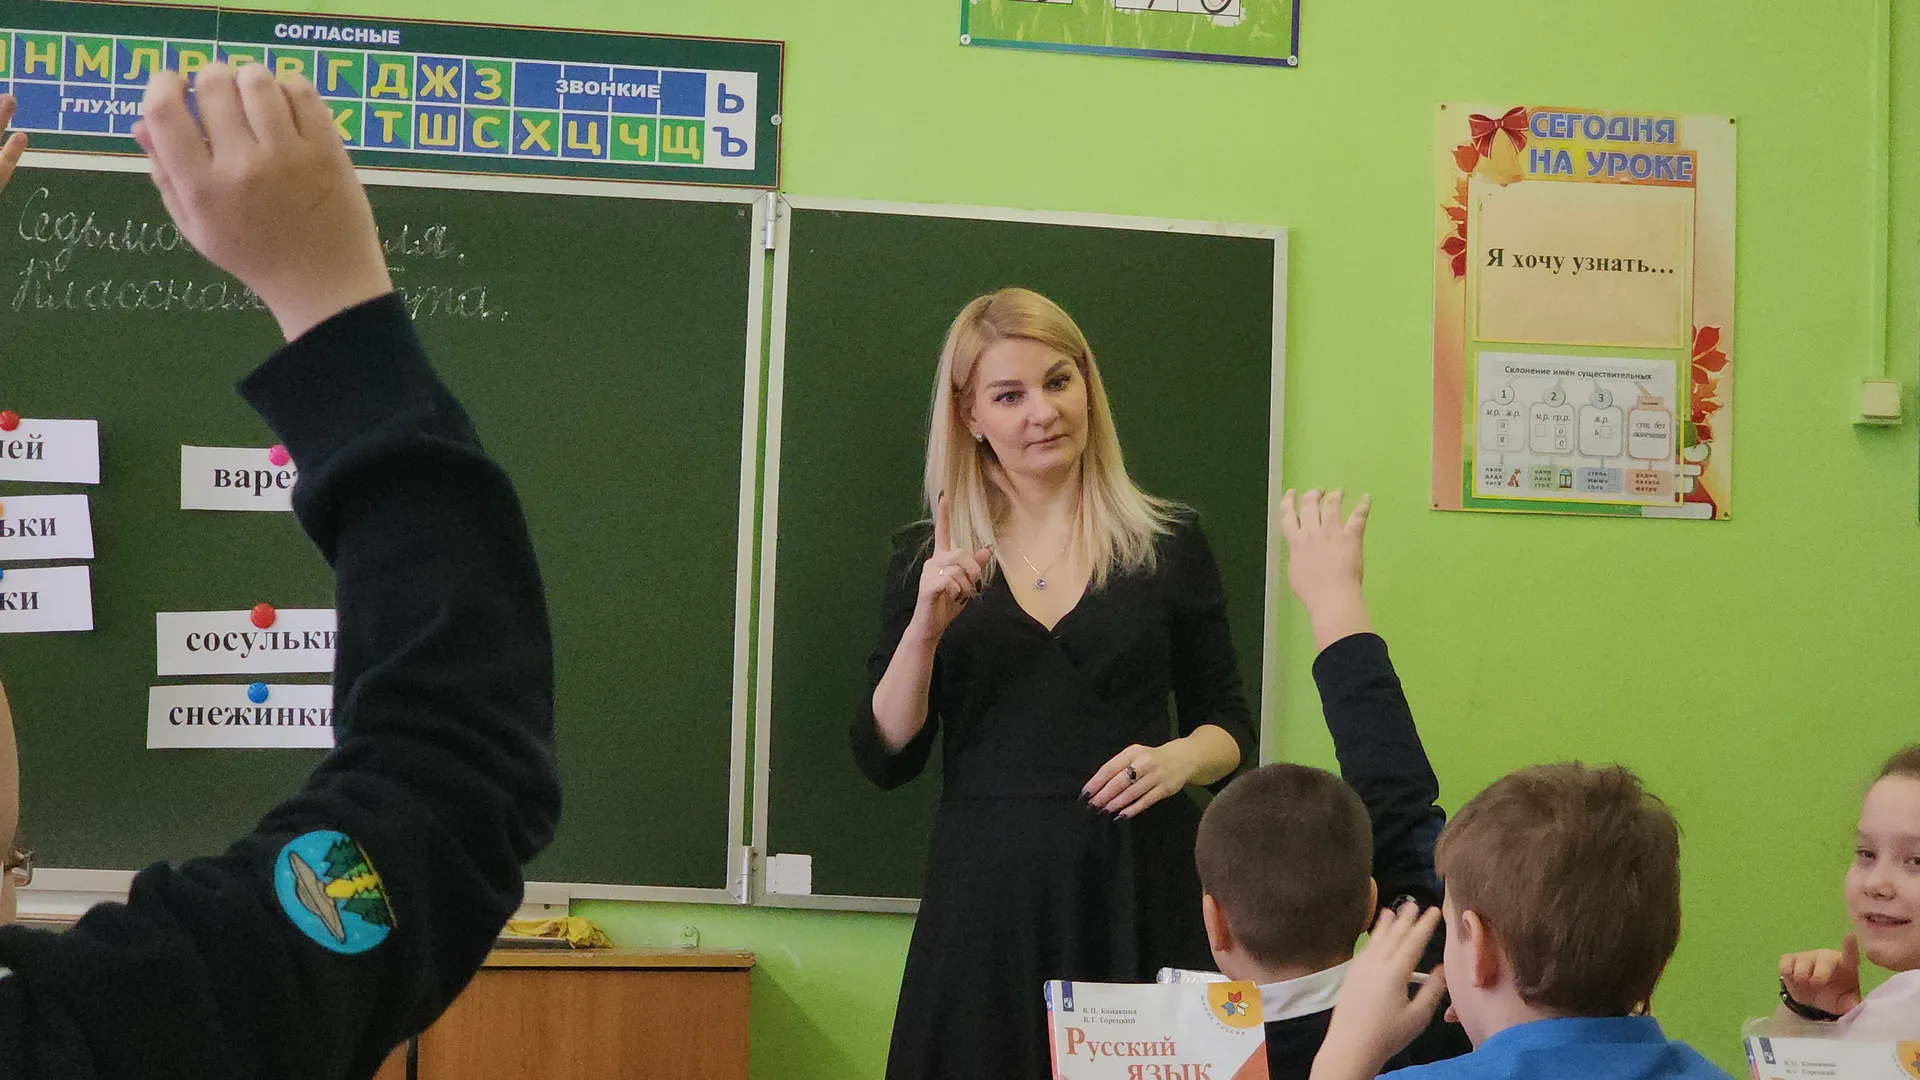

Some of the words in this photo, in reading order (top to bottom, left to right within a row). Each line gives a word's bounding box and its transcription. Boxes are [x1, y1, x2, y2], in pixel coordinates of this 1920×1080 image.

[274, 23, 400, 44] СОГЛАСНЫЕ
[25, 41, 56, 76] Н
[75, 44, 110, 78] М
[123, 48, 160, 80] Л
[327, 59, 353, 91] Г
[370, 63, 408, 99] Д
[419, 64, 459, 98] Ж
[474, 68, 503, 101] З
[555, 78, 661, 99] ЗВОНКИЕ
[717, 82, 745, 114] Ь
[374, 110, 403, 143] Т
[419, 113, 456, 147] Ш
[472, 115, 501, 149] С
[520, 117, 551, 151] Х
[567, 120, 601, 156] Ц
[619, 123, 647, 156] Ч
[662, 124, 700, 161] Щ
[1529, 111, 1676, 144] СЕГОДНЯ
[712, 126, 748, 157] Ъ
[1529, 148, 1574, 175] НА
[1586, 151, 1692, 181] УРОКЕ
[1486, 248, 1504, 267] Я
[1512, 253, 1565, 274] хочу
[1572, 255, 1674, 275] узнать...
[1504, 365, 1551, 376] Склонение
[1553, 368, 1575, 377] имён
[1577, 370, 1652, 380] существительных
[1501, 389, 1507, 399] 1
[1551, 392, 1557, 401] 2
[1598, 393, 1605, 403] 3
[186, 631, 338, 658] сосульки
[169, 705, 334, 727] снежинки
[1064, 1027, 1177, 1062] Русский
